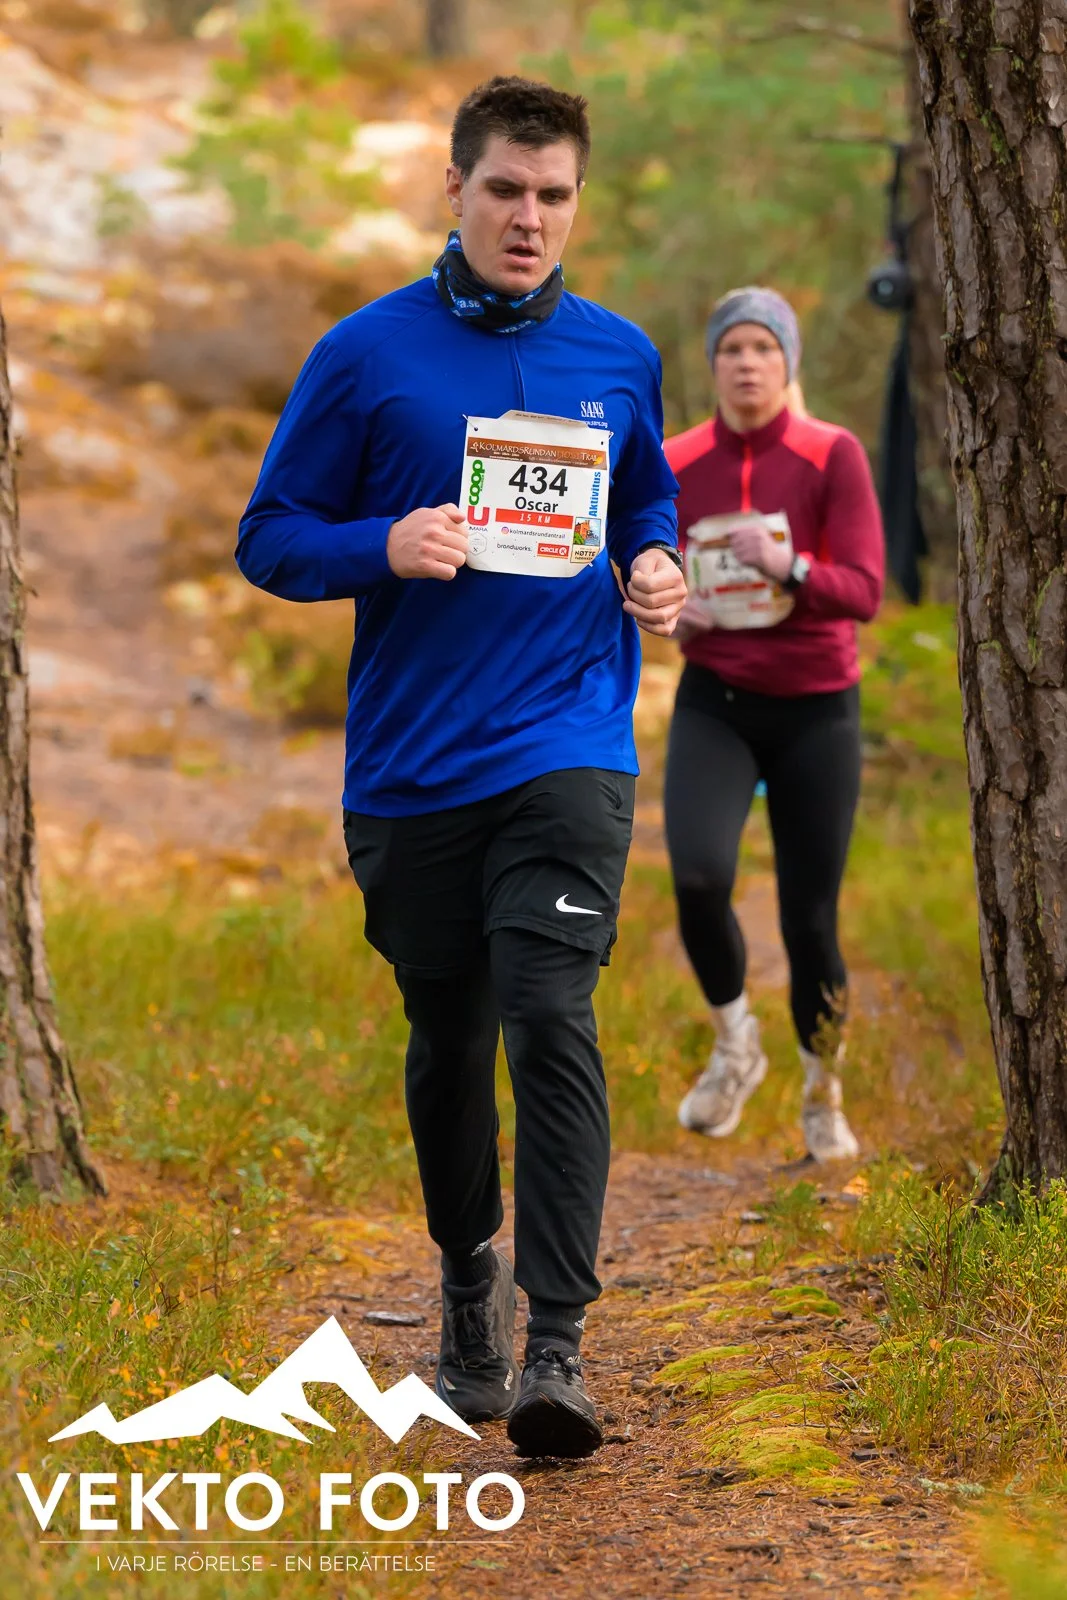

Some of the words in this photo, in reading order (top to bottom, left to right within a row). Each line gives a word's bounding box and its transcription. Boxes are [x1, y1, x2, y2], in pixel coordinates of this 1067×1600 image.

[580, 400, 605, 419] SANS
[469, 459, 485, 506] coop
[508, 464, 568, 497] 434
[588, 471, 601, 517] Aktivitus
[515, 496, 559, 513] Oscar
[519, 512, 532, 523] 15
[537, 514, 551, 524] KM
[509, 528, 566, 539] kolmardsrundantrail
[540, 546, 559, 554] CIRCLE
